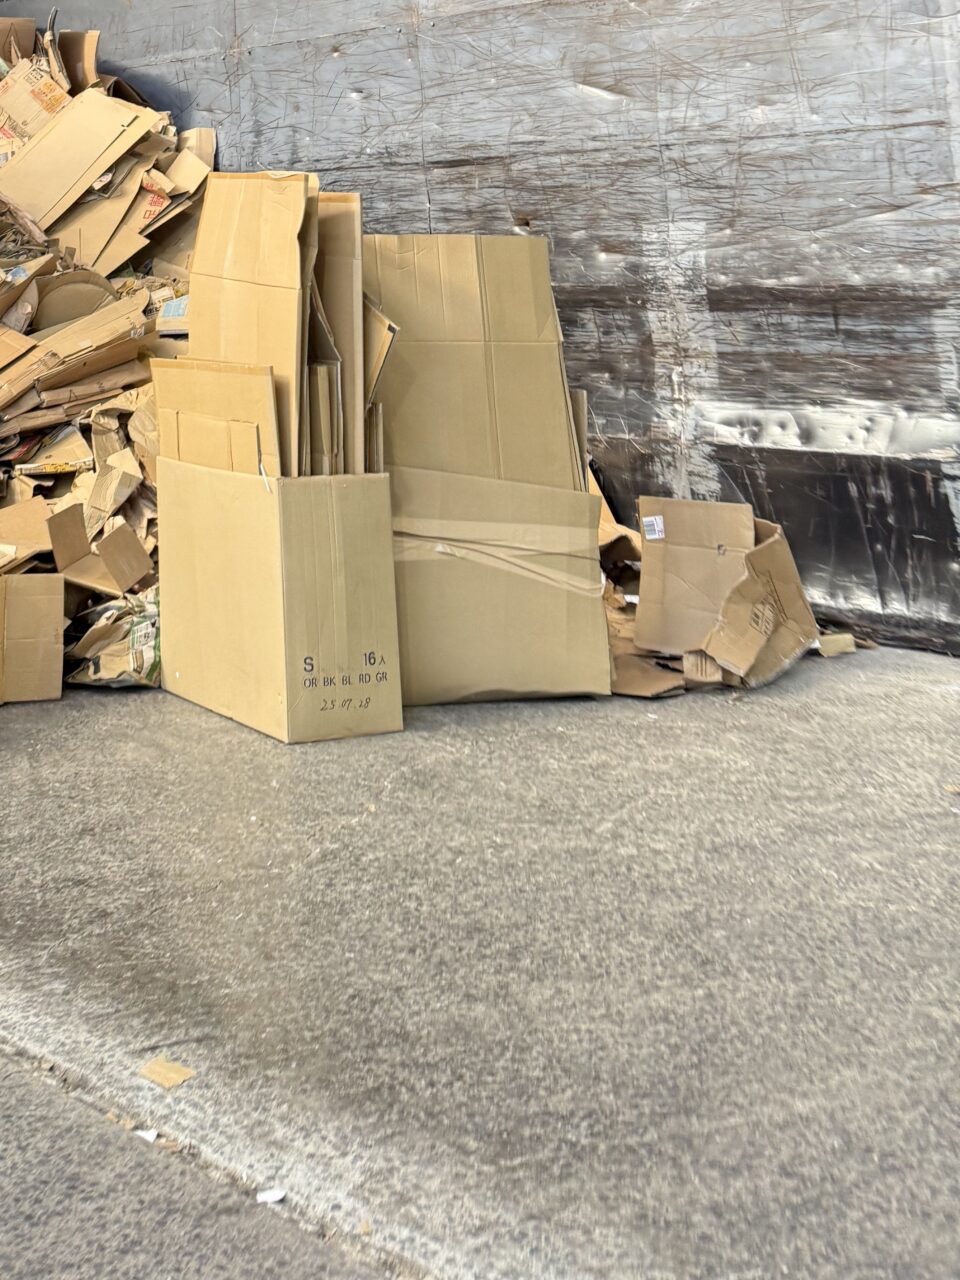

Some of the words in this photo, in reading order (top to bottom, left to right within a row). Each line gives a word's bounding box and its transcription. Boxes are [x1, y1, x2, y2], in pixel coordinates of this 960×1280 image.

[303, 656, 314, 672] S
[303, 677, 318, 689] OR
[323, 676, 336, 687] BK
[358, 673, 371, 684] RD
[375, 671, 388, 683] GR
